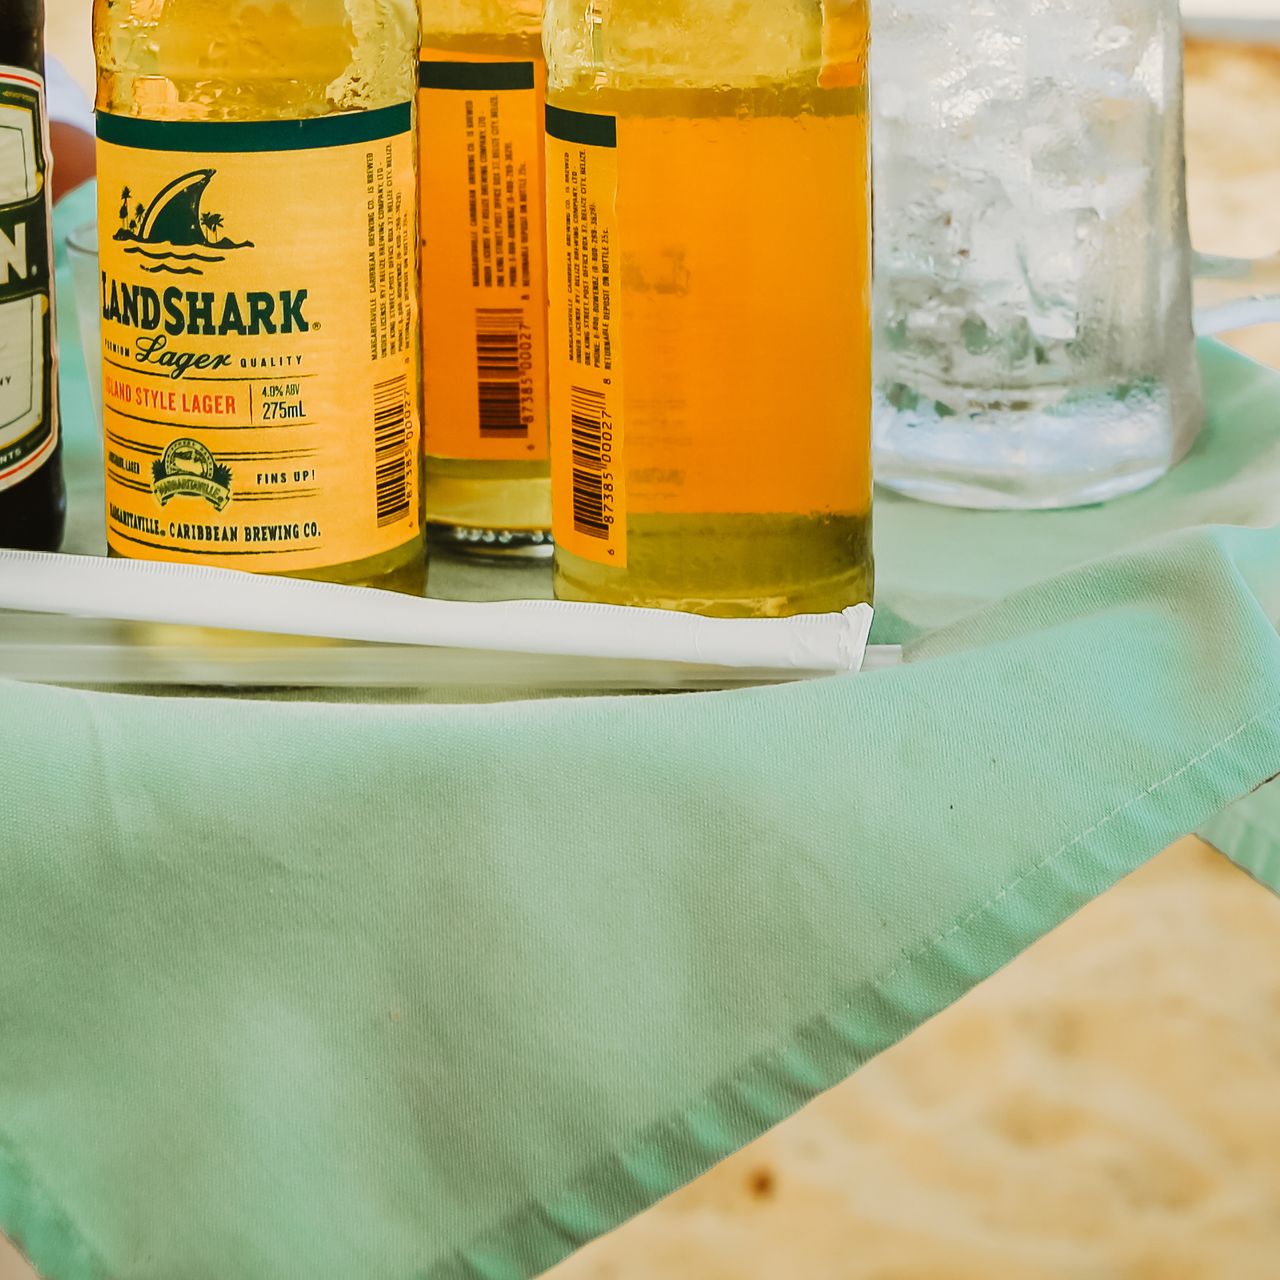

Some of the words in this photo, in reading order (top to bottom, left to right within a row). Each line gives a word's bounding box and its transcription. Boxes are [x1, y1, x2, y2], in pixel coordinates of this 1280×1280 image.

[601, 247, 609, 272] BOTTLE
[602, 277, 609, 286] ON
[135, 335, 232, 379] Lager
[240, 355, 302, 368] QUALITY
[519, 323, 532, 370] 00027
[136, 386, 176, 410] STYLE
[182, 394, 236, 414] LAGER
[285, 384, 300, 395] ABV
[521, 378, 533, 423] 87385
[263, 400, 306, 419] 275mL
[404, 389, 413, 440] 00027
[601, 409, 612, 463] 00027
[256, 471, 287, 485] FINS
[293, 468, 315, 482] UP!
[603, 472, 614, 524] 87385
[169, 522, 238, 542] CARIBBEAN
[244, 524, 299, 541] BREWING
[303, 521, 322, 538] CO.
[607, 548, 615, 556] 6
